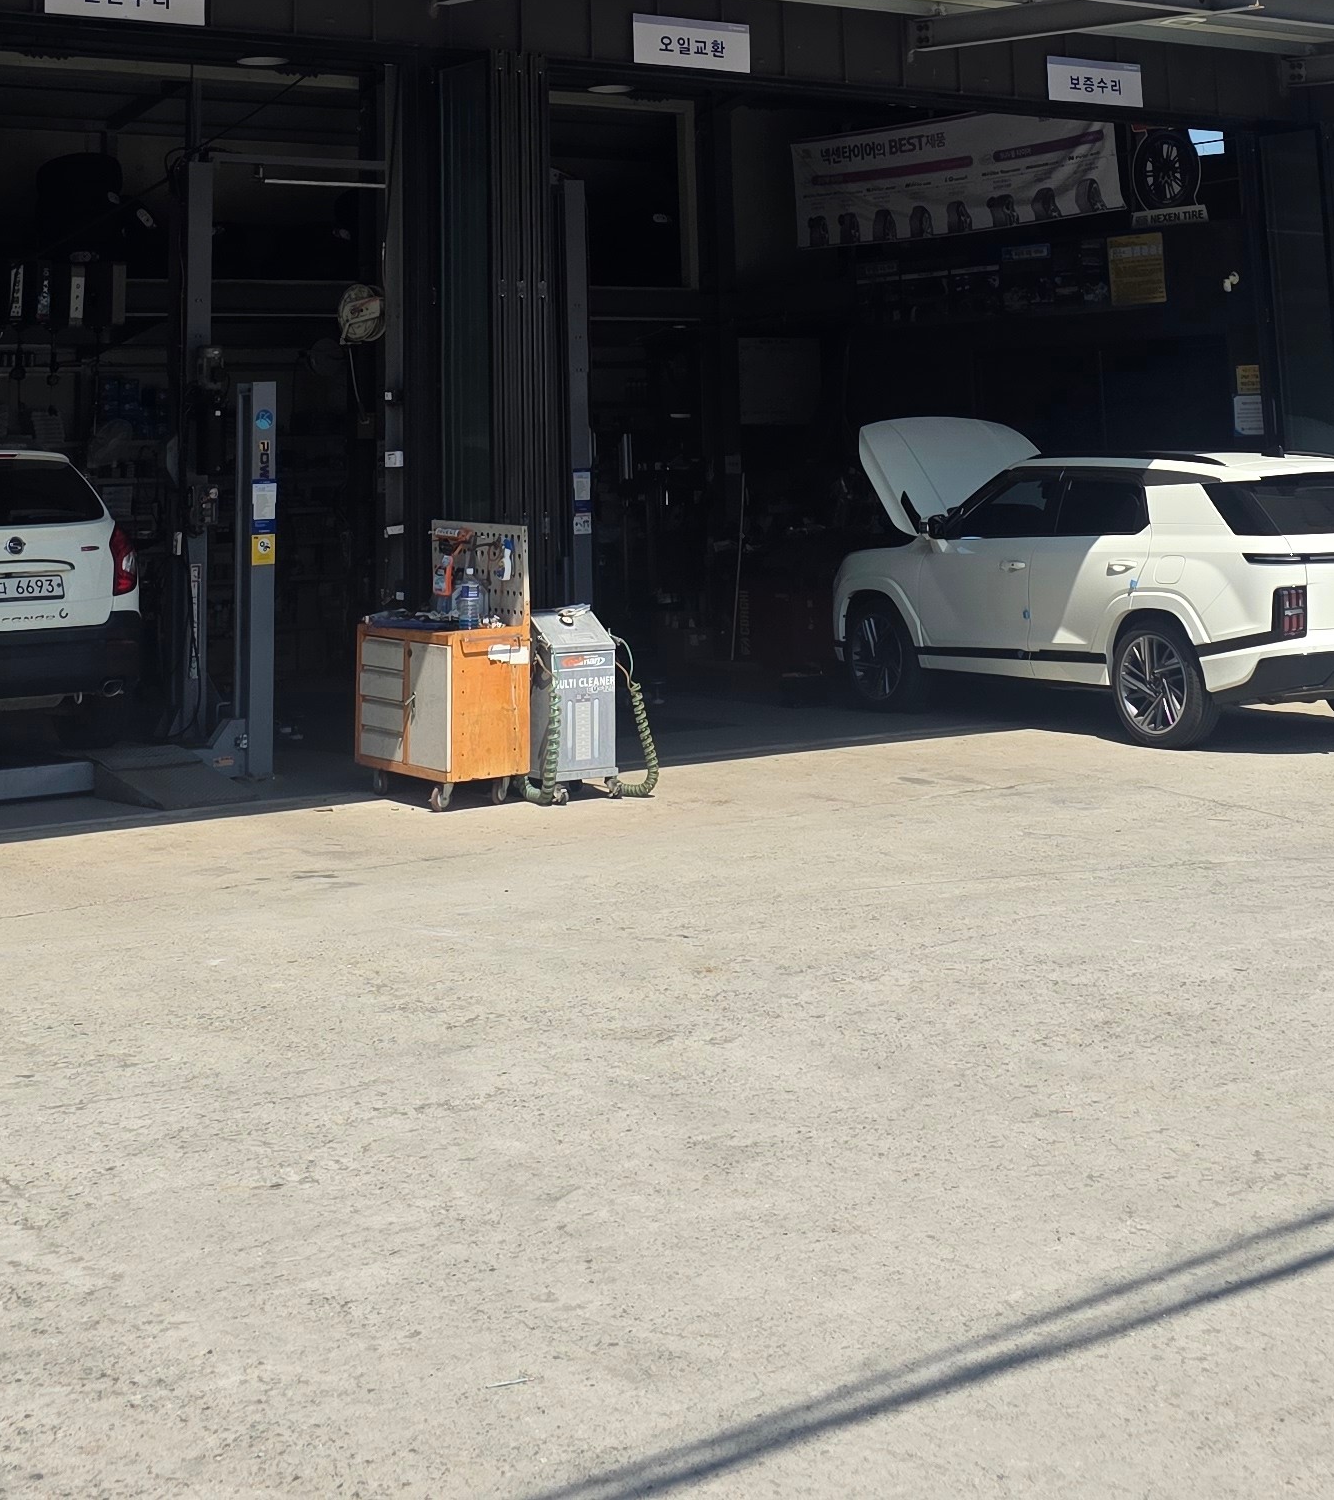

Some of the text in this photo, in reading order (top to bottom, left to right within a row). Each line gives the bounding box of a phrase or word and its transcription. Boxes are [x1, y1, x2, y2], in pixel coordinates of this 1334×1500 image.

[659, 35, 725, 58] 오일교환
[1069, 75, 1121, 95] 보증수리
[888, 134, 924, 155] BEST
[925, 132, 946, 149] 제품
[1150, 210, 1204, 224] NEXEN TIRE
[16, 578, 54, 595] 6693
